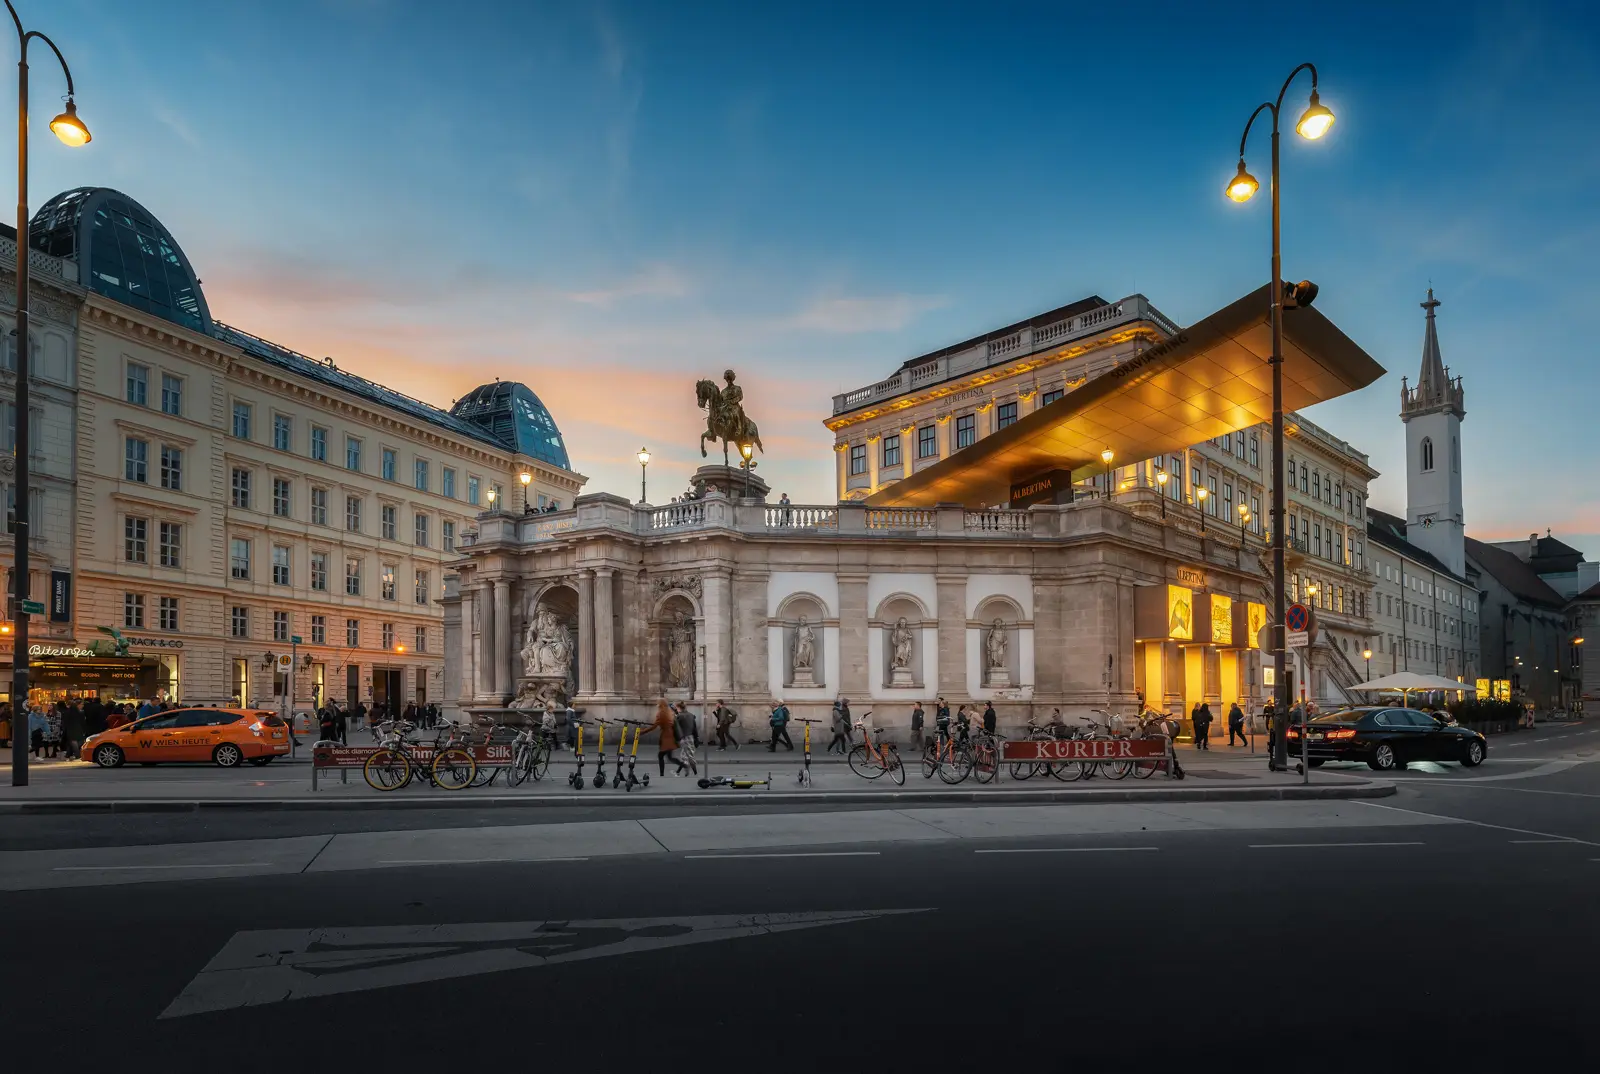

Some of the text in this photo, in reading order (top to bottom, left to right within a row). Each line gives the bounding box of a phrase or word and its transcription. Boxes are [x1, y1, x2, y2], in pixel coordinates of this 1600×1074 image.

[1110, 334, 1189, 378] SORAVIA WING
[943, 388, 984, 405] ALBERTINA
[1012, 479, 1052, 500] ALBERTINA
[1176, 568, 1205, 585] ALBERTINA
[28, 644, 96, 659] Bitzinger
[159, 639, 167, 647] &
[168, 640, 184, 649] CO
[466, 746, 476, 758] &
[486, 745, 511, 758] Silk
[1035, 741, 1134, 759] KURIER
